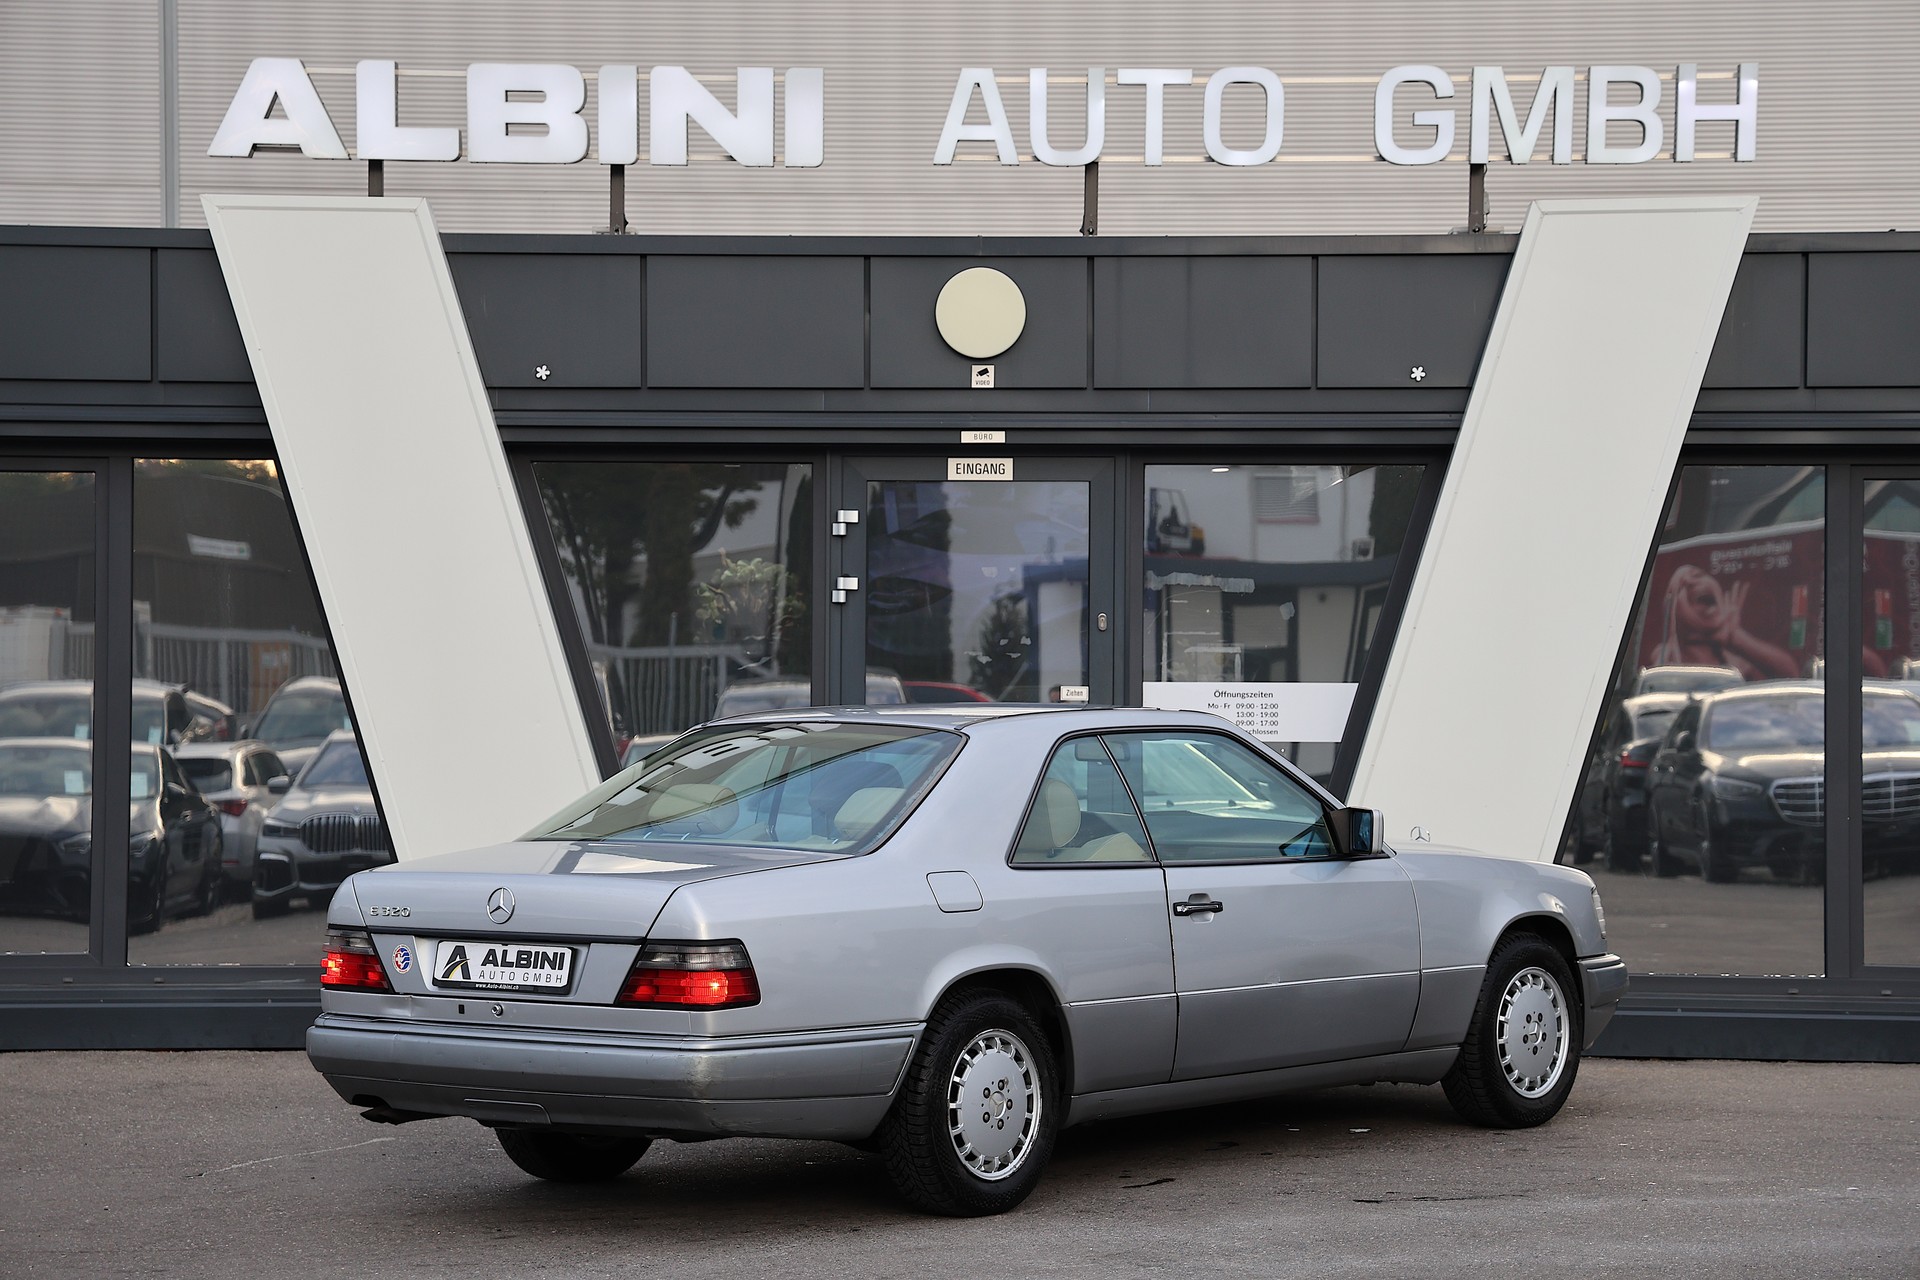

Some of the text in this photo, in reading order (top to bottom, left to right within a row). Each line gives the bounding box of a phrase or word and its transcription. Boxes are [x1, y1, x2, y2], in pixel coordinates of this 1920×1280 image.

[207, 57, 1759, 167] ALBINI AUTO GMBH
[956, 463, 1006, 474] EINGANG
[1214, 690, 1274, 699] Öffnungszeiten
[370, 906, 411, 917] E 320
[480, 948, 566, 970] ALBINI
[478, 970, 562, 984] AUTO GMBH
